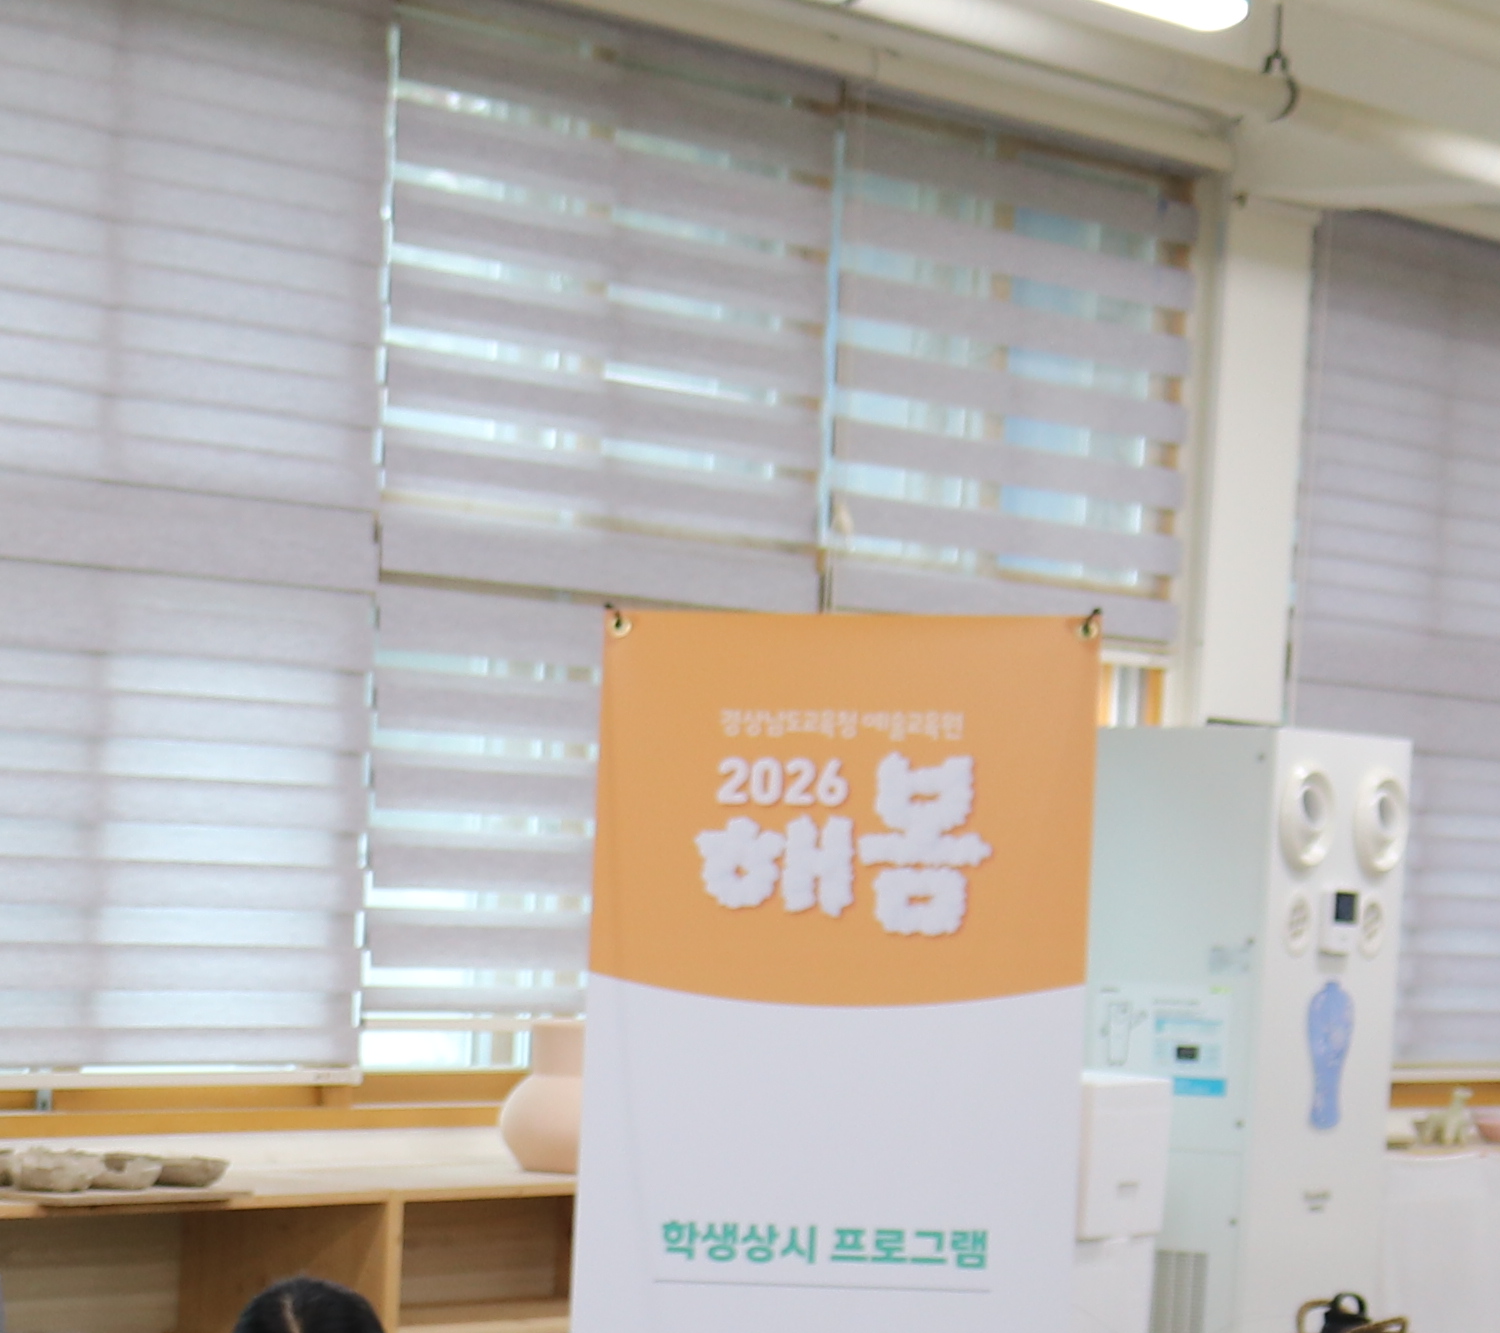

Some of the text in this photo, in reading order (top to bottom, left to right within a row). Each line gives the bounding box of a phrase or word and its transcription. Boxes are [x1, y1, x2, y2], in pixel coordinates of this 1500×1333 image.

[715, 755, 850, 807] 2026
[693, 751, 993, 938] 해봄
[661, 1219, 990, 1271] 학생상시 프로그램
